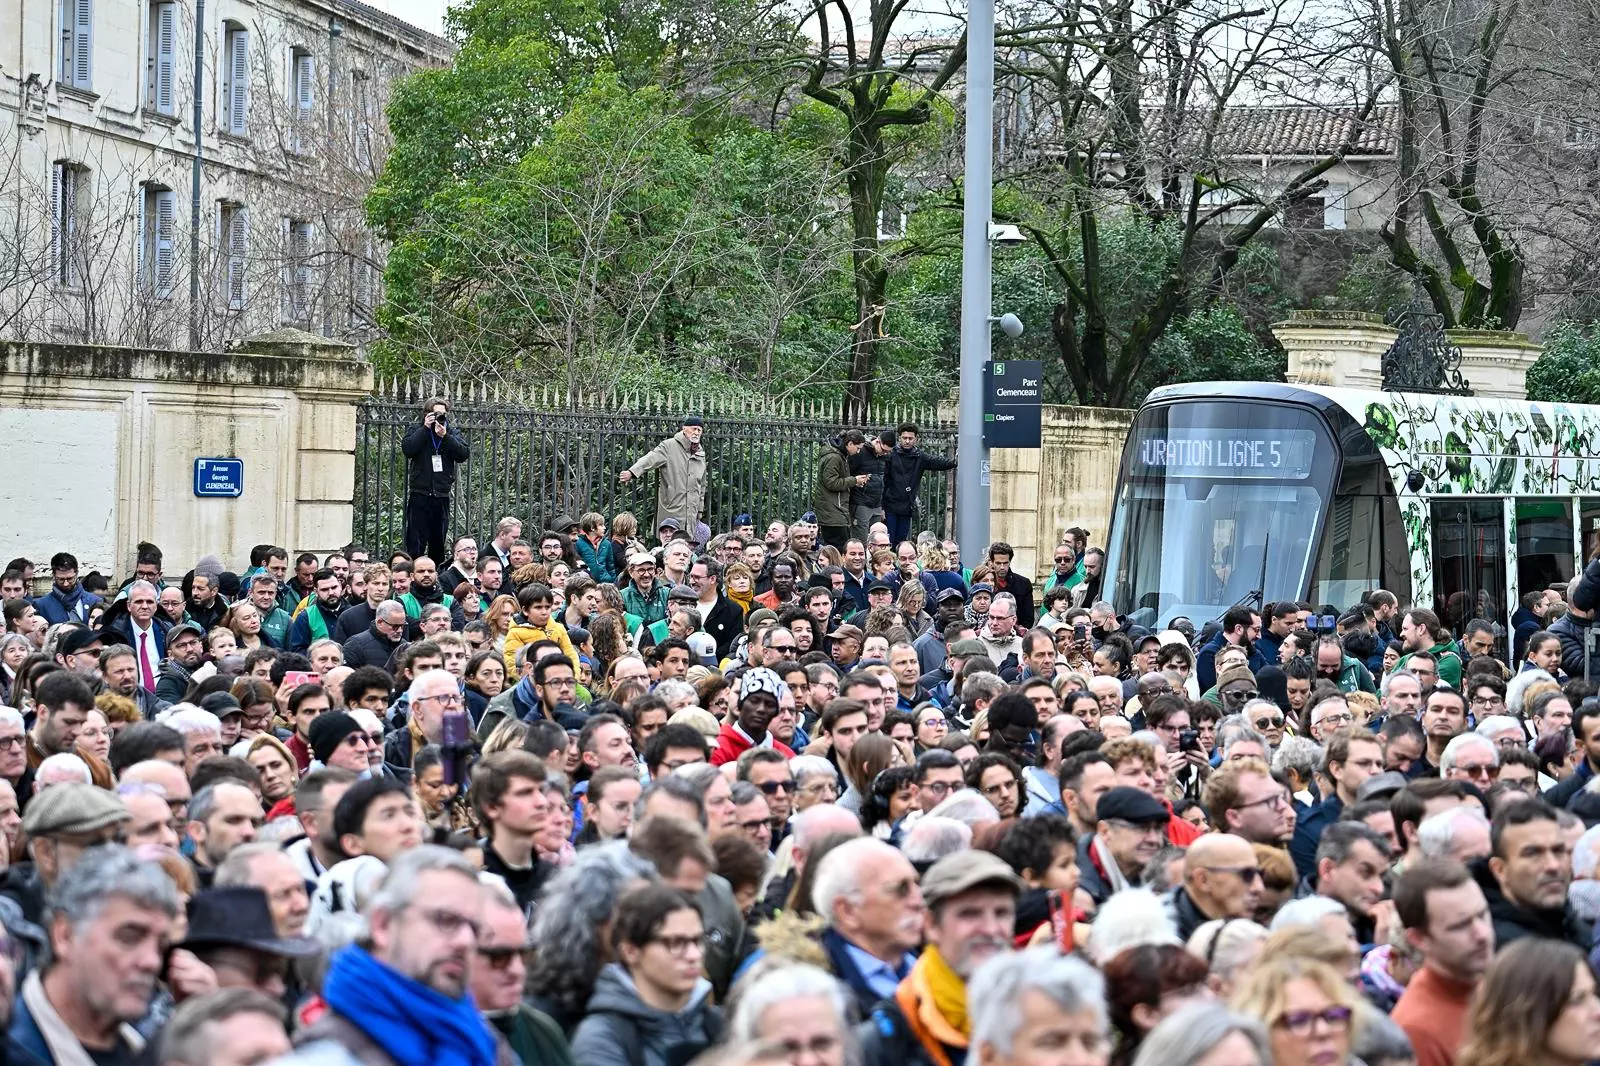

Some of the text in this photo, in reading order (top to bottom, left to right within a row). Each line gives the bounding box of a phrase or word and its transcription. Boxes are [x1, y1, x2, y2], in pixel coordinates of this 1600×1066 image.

[996, 364, 1003, 374] 5
[1022, 378, 1038, 387] Parc
[996, 388, 1038, 397] Clemenceau
[995, 414, 1015, 422] Clapiers
[1217, 440, 1265, 467] LIGNE
[1269, 440, 1281, 468] 5
[211, 473, 229, 482] Georges
[205, 482, 235, 490] CLEMENCEAU
